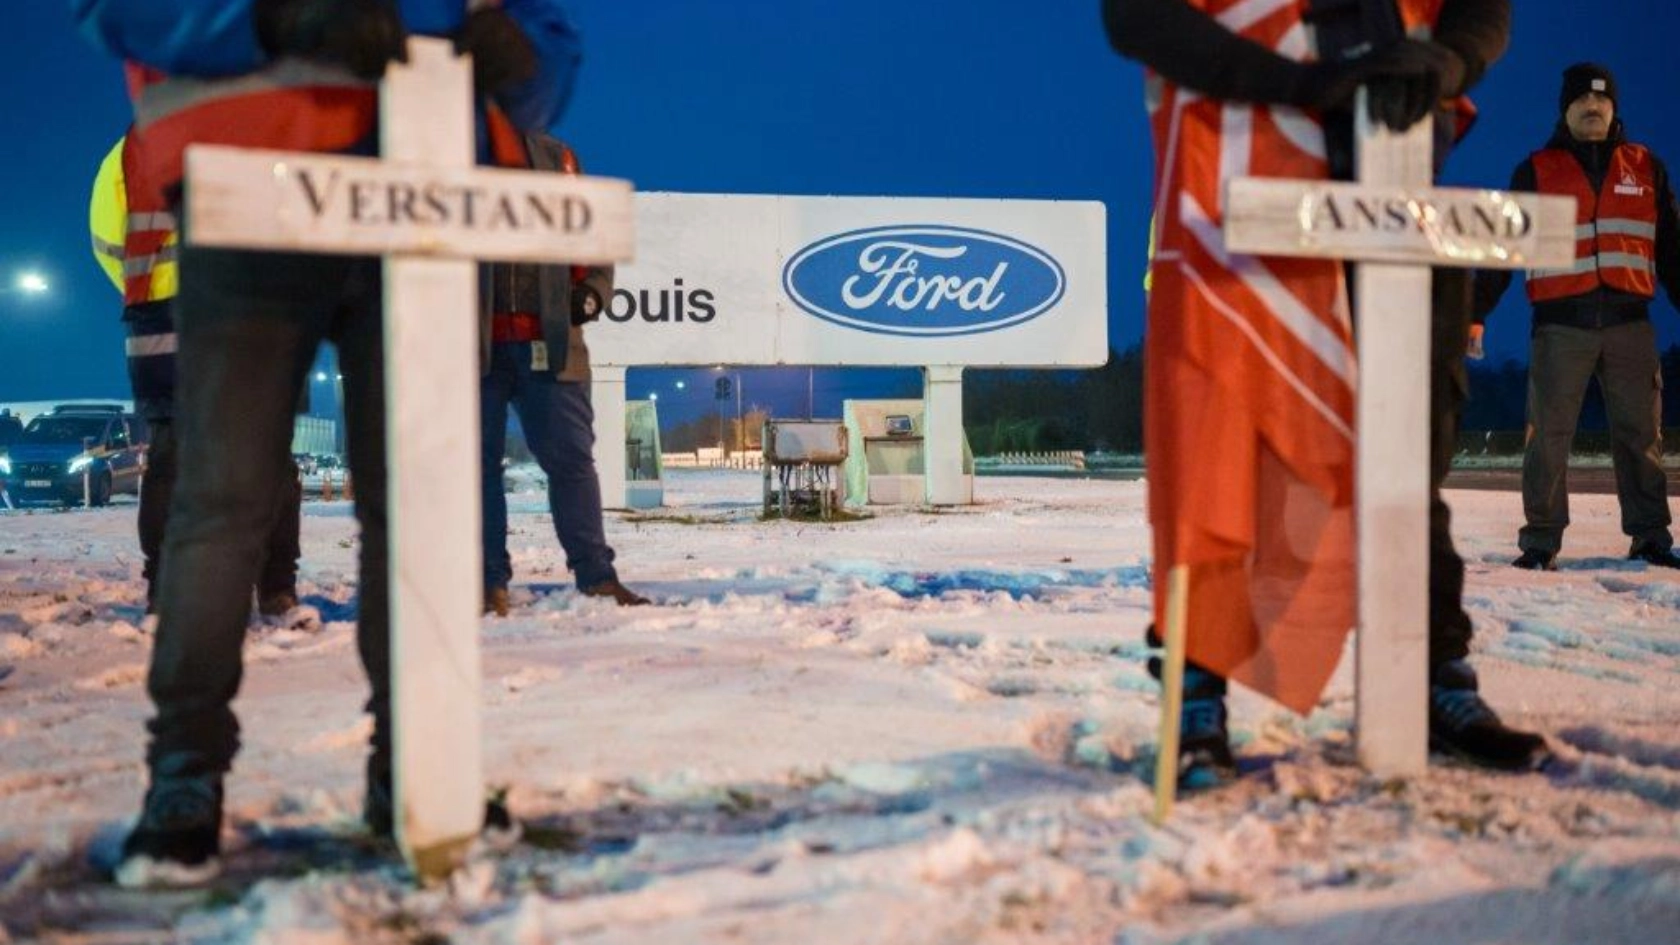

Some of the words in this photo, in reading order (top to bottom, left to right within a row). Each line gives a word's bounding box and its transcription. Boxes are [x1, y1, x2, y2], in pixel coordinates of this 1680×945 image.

[296, 168, 592, 233] VERSTAND
[594, 278, 716, 323] ouis
[841, 240, 1008, 311] Ford
